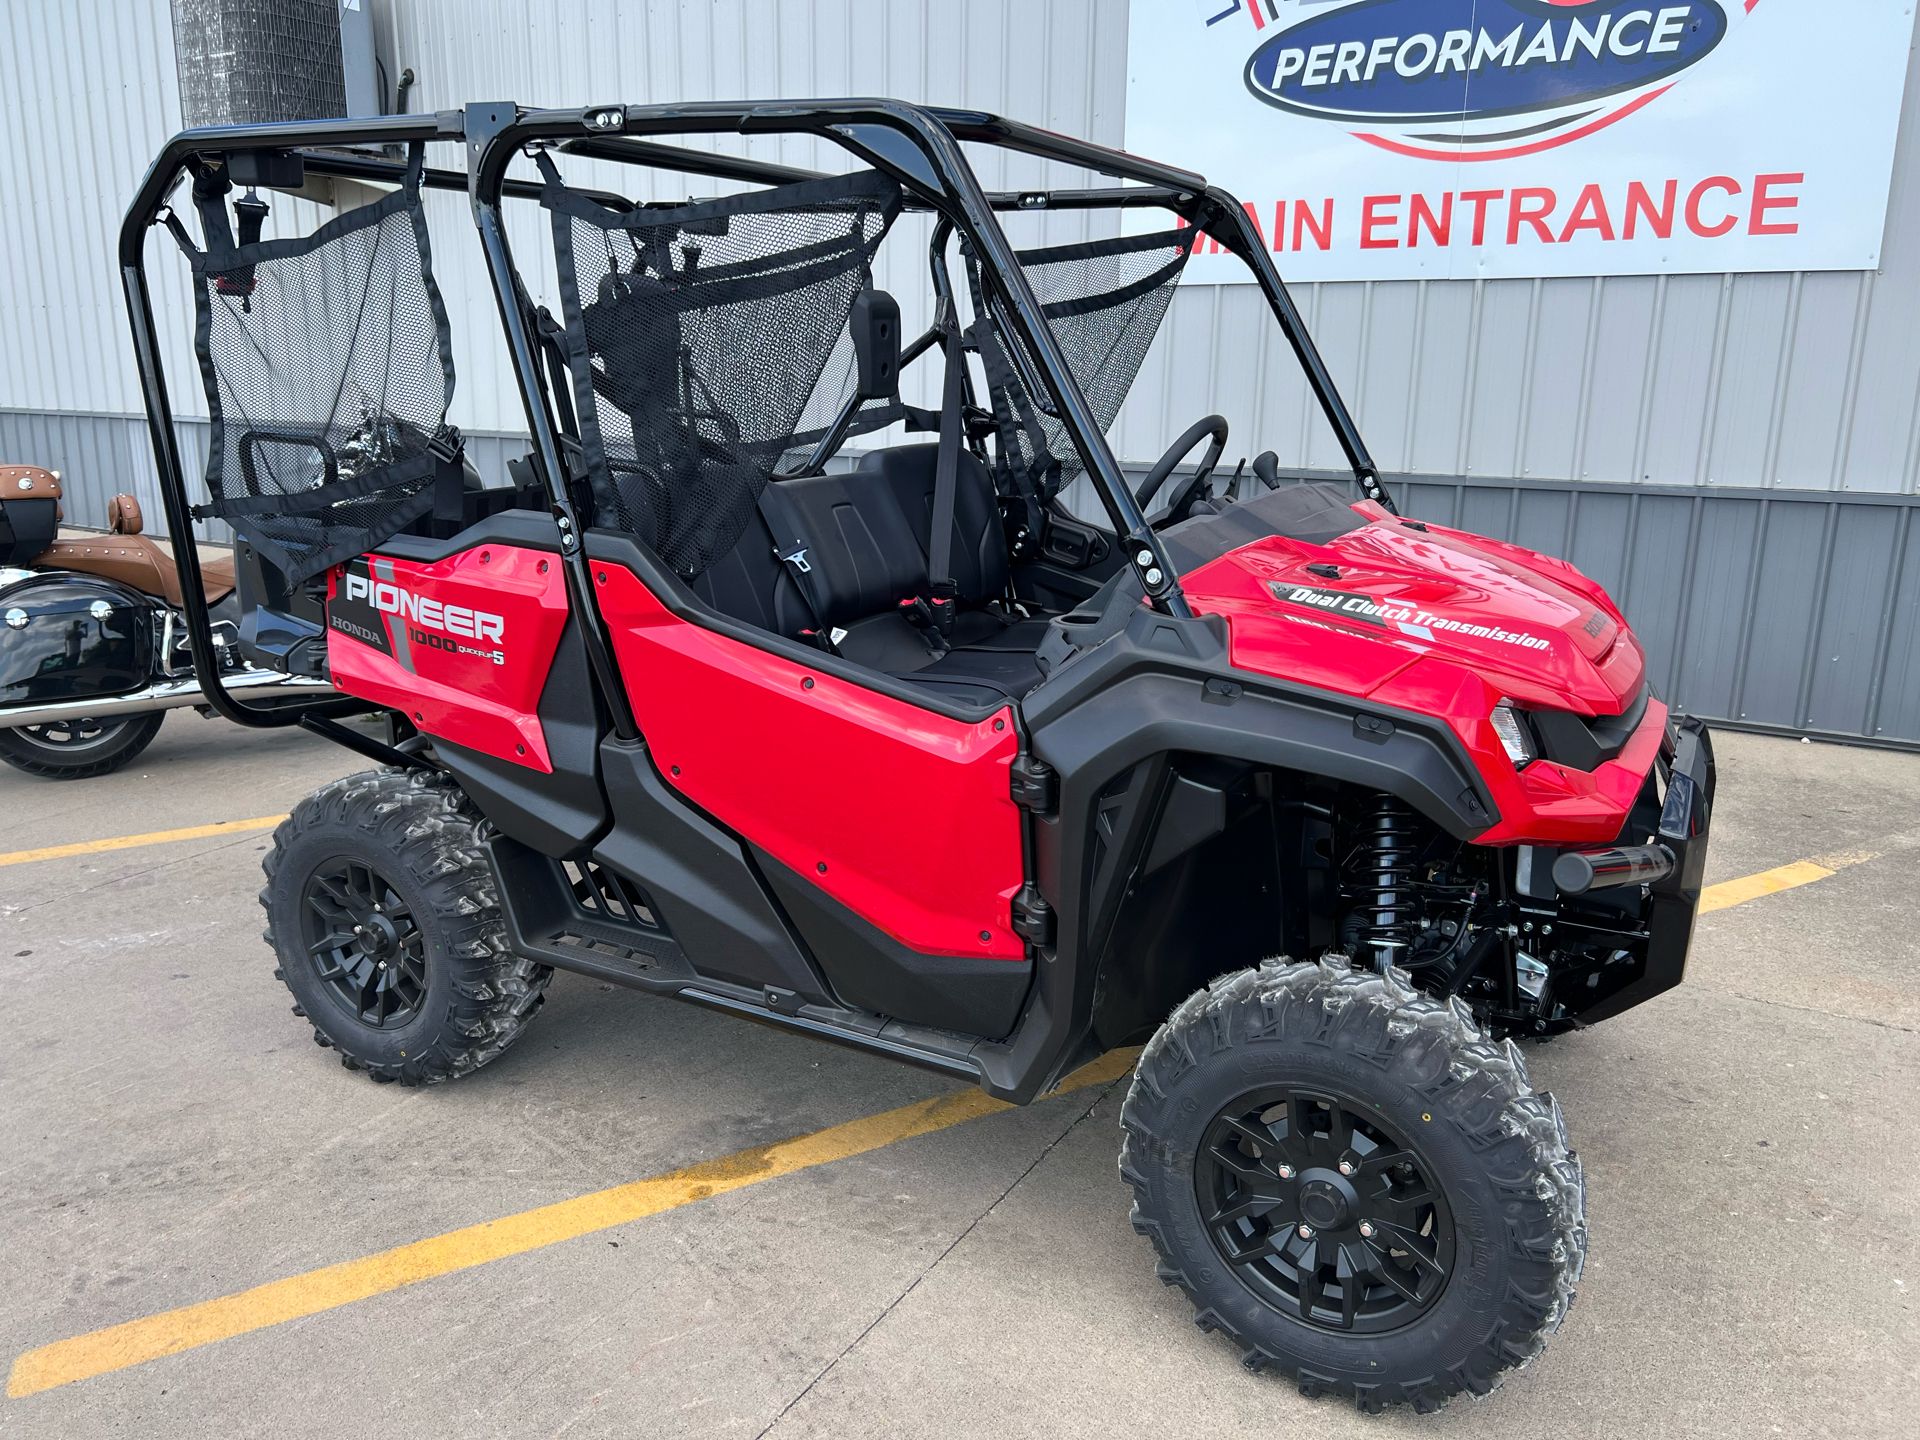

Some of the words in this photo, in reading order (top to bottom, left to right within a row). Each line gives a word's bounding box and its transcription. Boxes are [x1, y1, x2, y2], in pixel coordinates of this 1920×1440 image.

[1271, 6, 1688, 91] PERFORMANCE
[1360, 172, 1805, 250] ENTRANCE
[330, 615, 382, 645] HONDA
[346, 573, 504, 645] PIONEER
[409, 626, 458, 653] 1000
[1288, 588, 1344, 608] Dual
[1341, 598, 1411, 621] Clutch
[1413, 610, 1550, 650] Transmission
